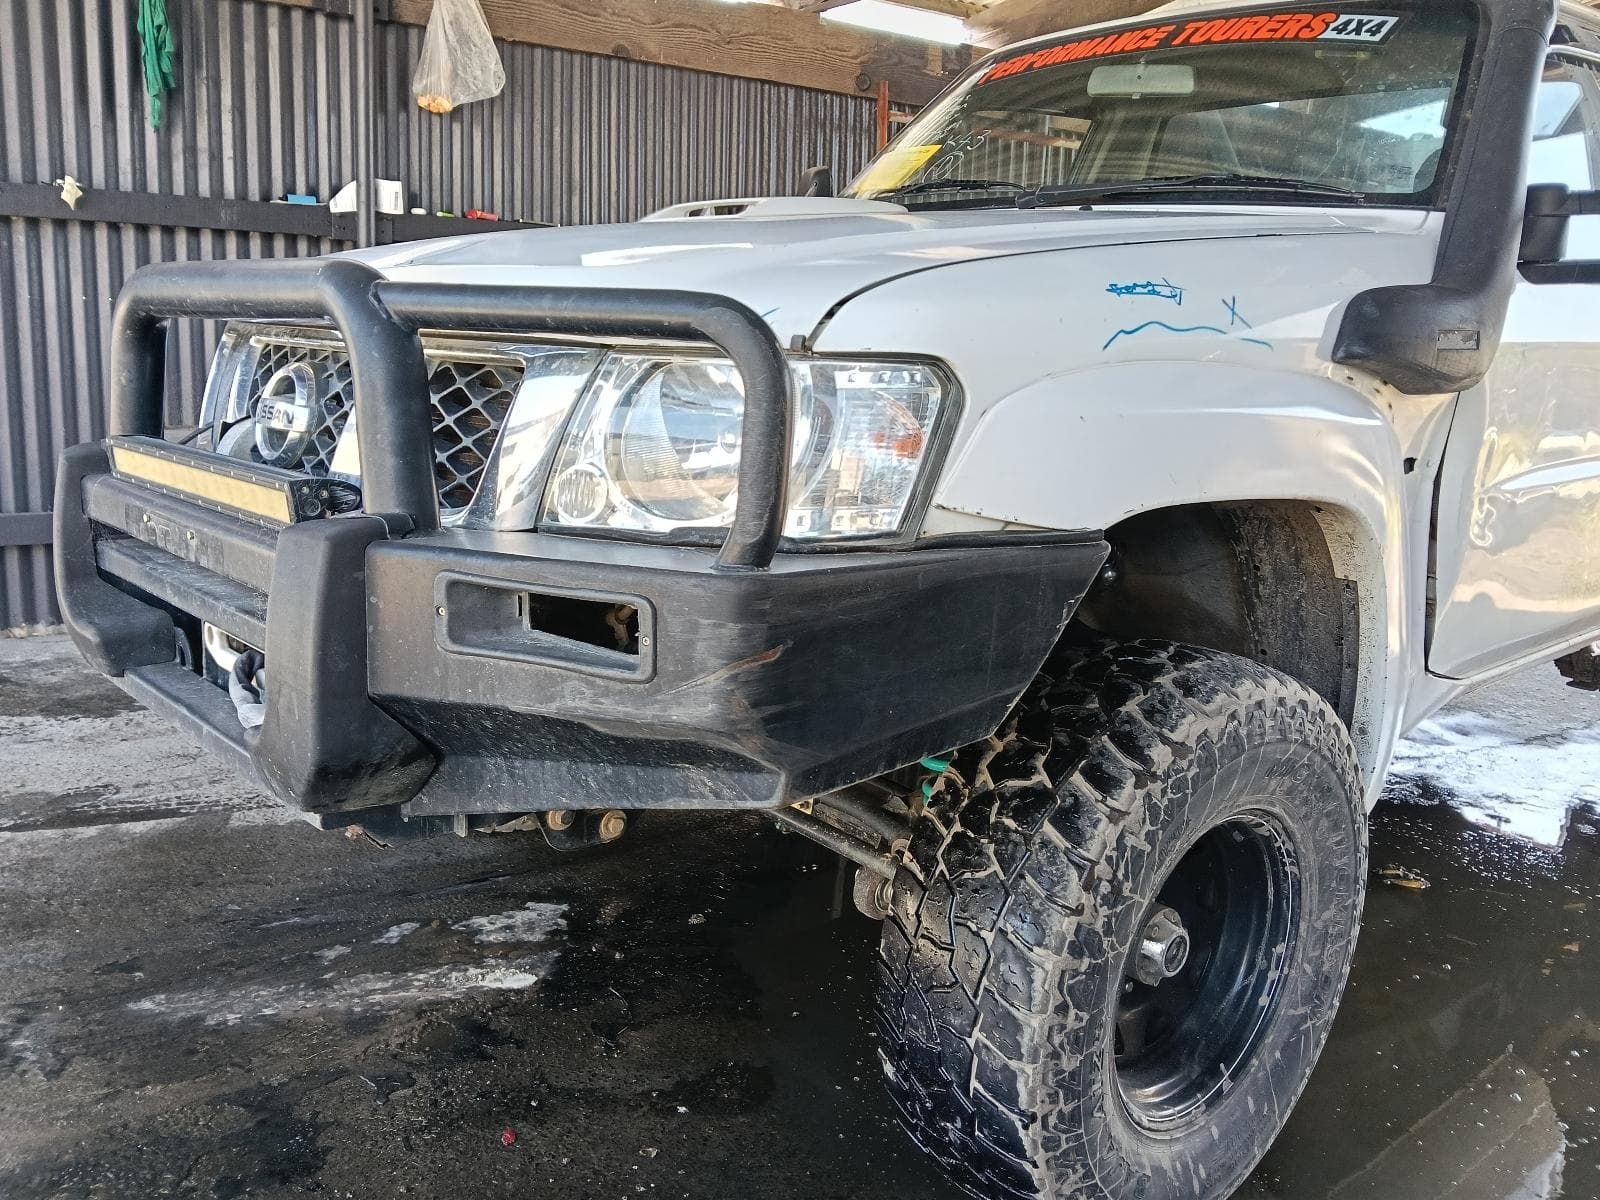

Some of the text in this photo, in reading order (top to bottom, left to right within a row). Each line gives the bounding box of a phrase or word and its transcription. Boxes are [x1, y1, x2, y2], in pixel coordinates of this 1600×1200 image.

[977, 12, 1388, 85] PERFORMANCE TOURERS 4X4
[257, 403, 295, 425] SSAN
